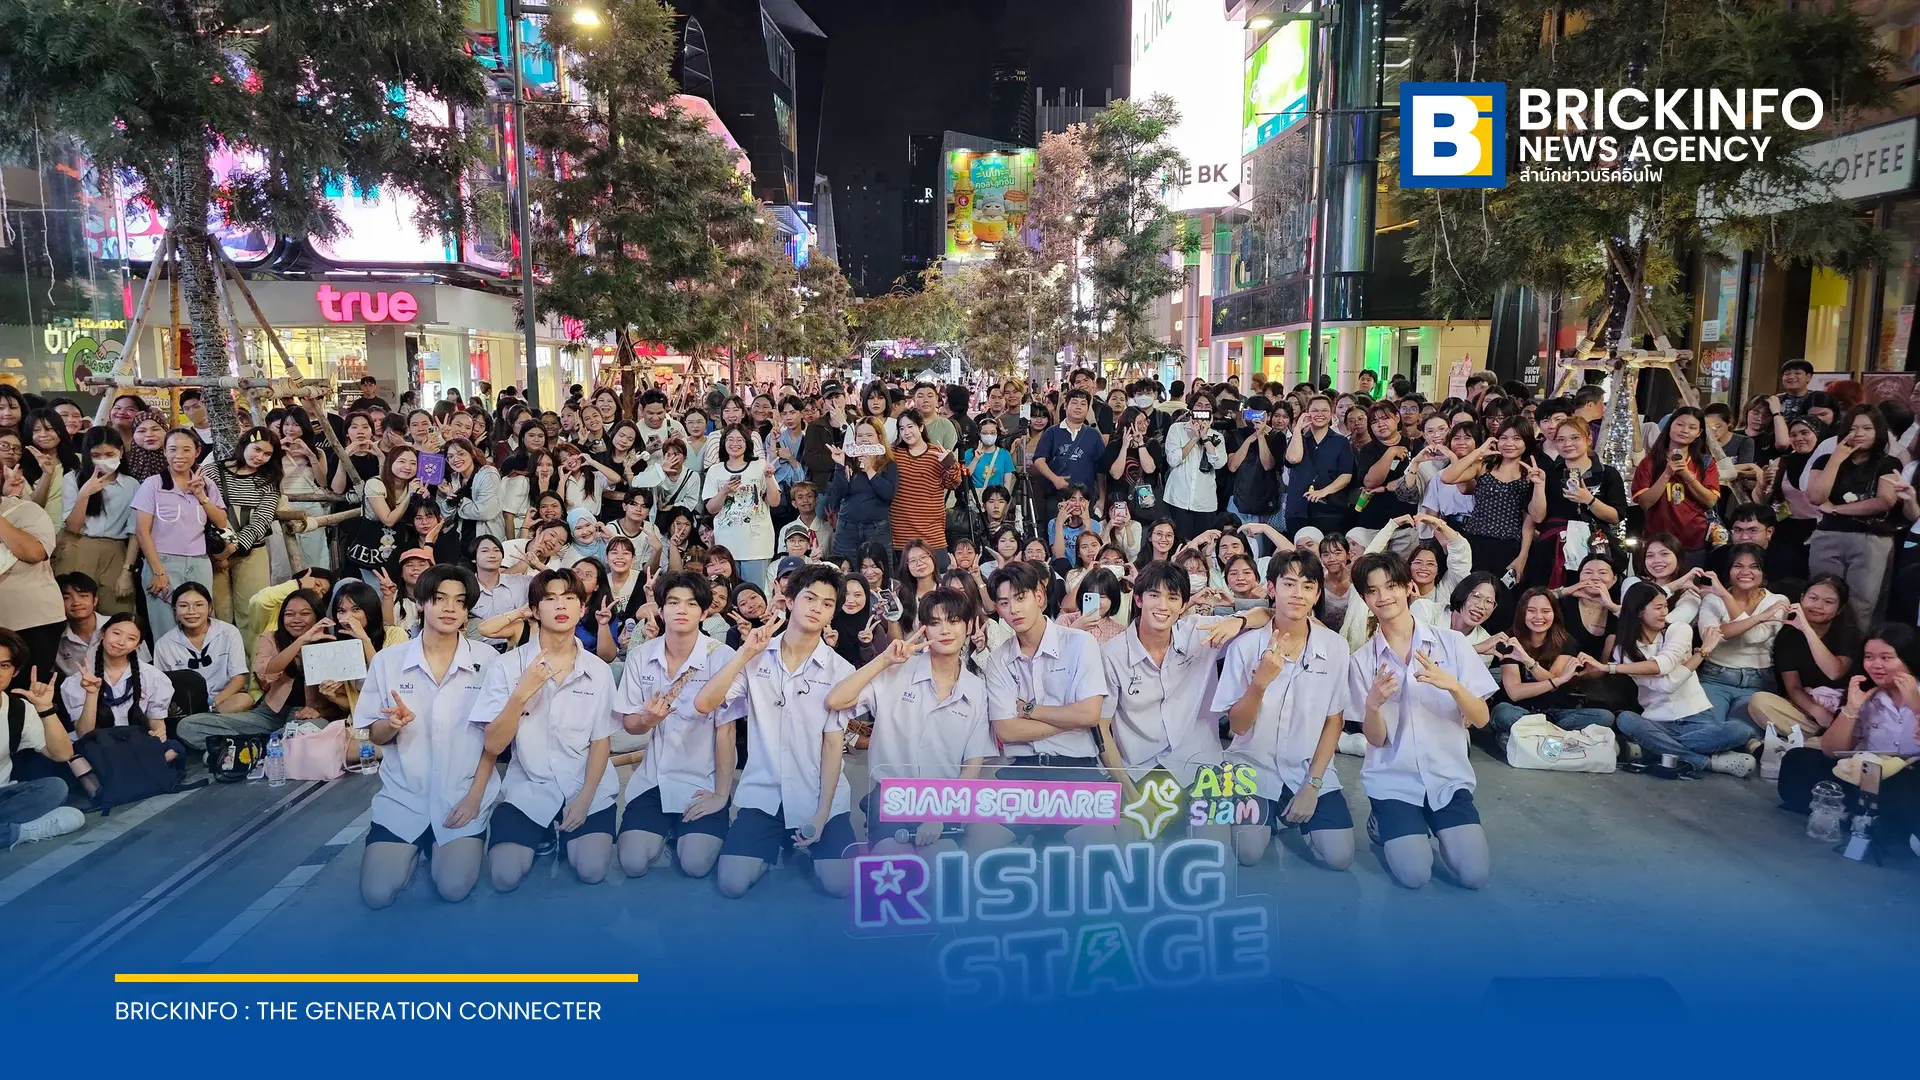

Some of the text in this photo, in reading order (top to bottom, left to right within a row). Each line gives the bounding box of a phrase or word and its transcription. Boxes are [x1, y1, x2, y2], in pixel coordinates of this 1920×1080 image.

[1198, 163, 1228, 184] BK
[1816, 143, 1906, 186] COFFEE
[316, 283, 418, 323] true
[1524, 366, 1540, 375] JUICY
[1524, 375, 1540, 384] BABY
[1192, 411, 1210, 419] TOBI
[1665, 482, 1685, 503] 10
[883, 786, 1118, 823] SIAM SQUARE
[853, 839, 1228, 928] RISING
[941, 908, 1270, 1003] STAGE
